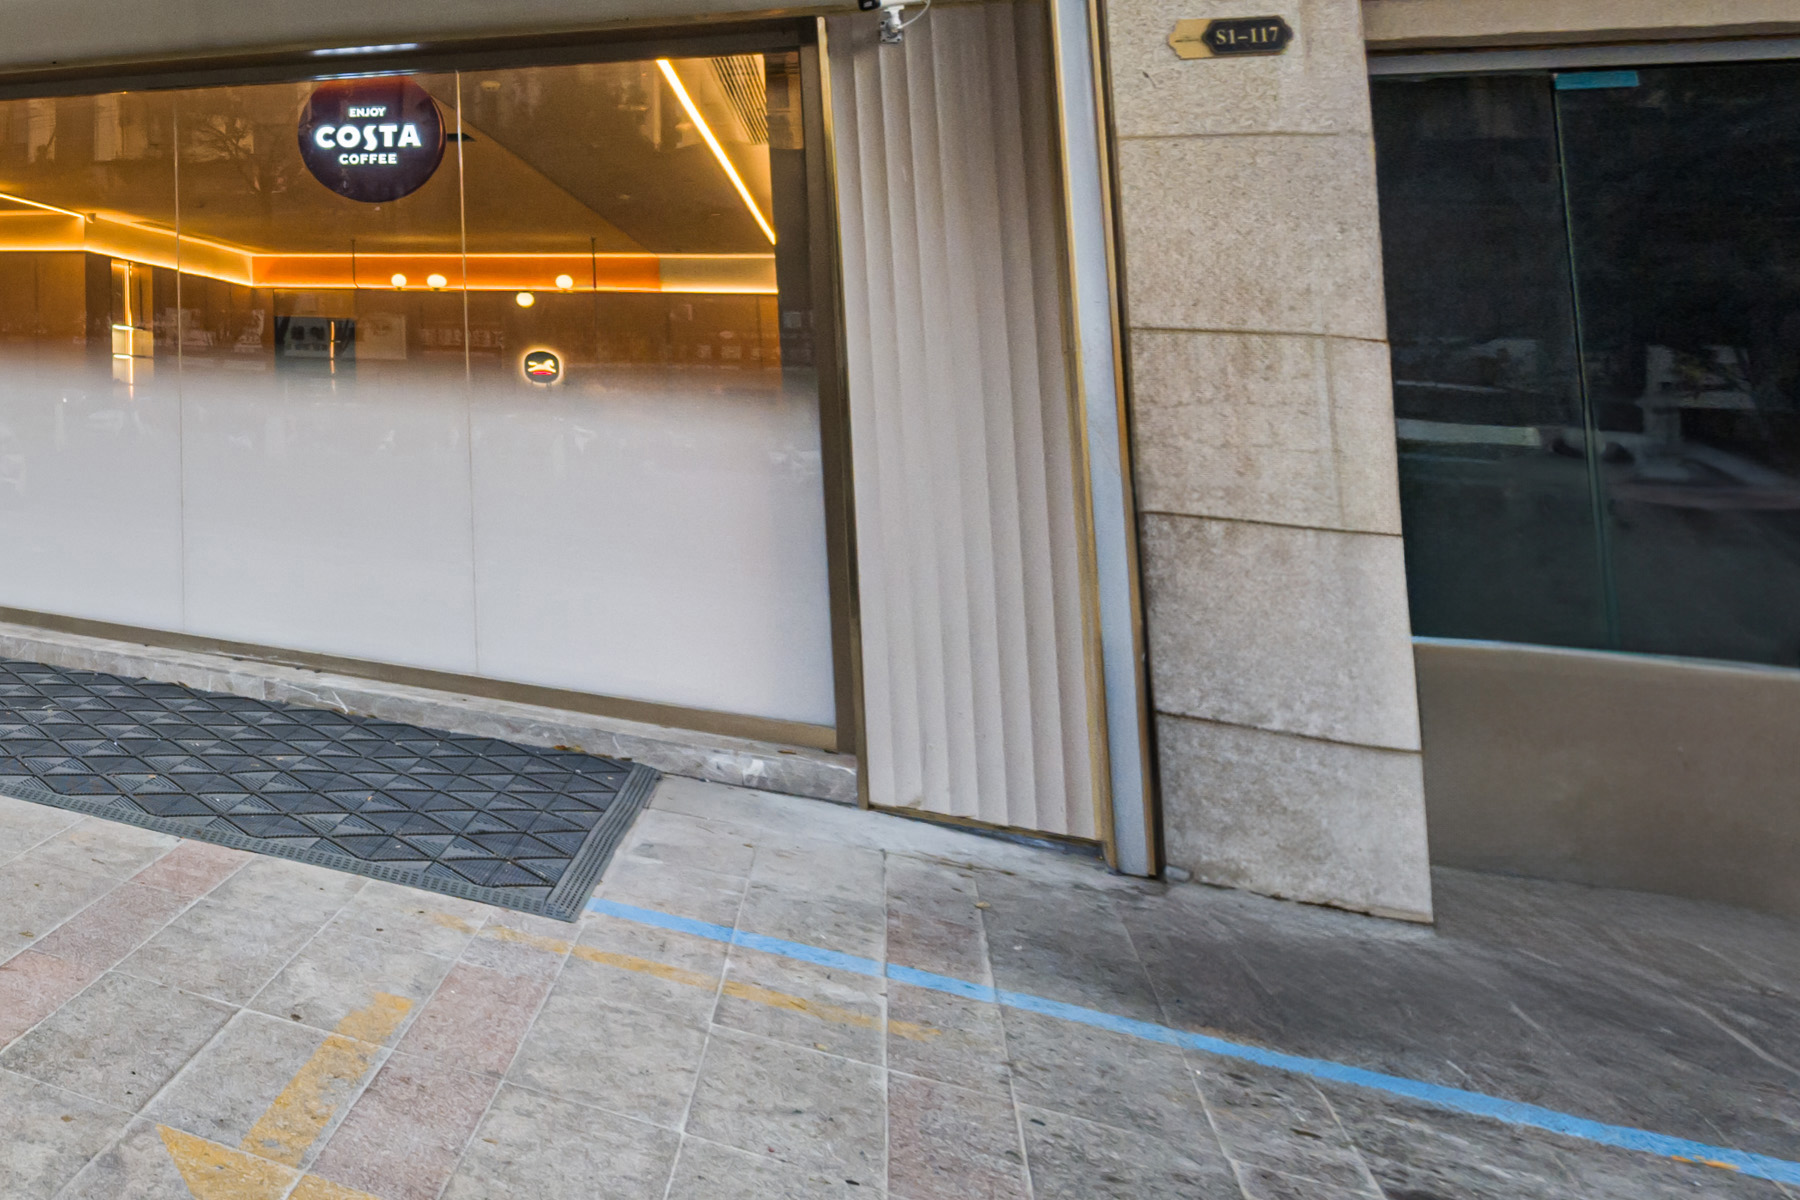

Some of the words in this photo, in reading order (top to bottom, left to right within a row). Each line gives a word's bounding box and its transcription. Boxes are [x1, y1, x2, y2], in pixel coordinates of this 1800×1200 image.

[1215, 26, 1278, 45] S1-117
[348, 106, 386, 117] ENJOY
[315, 124, 422, 151] COSTA
[339, 153, 398, 165] COFFEE
